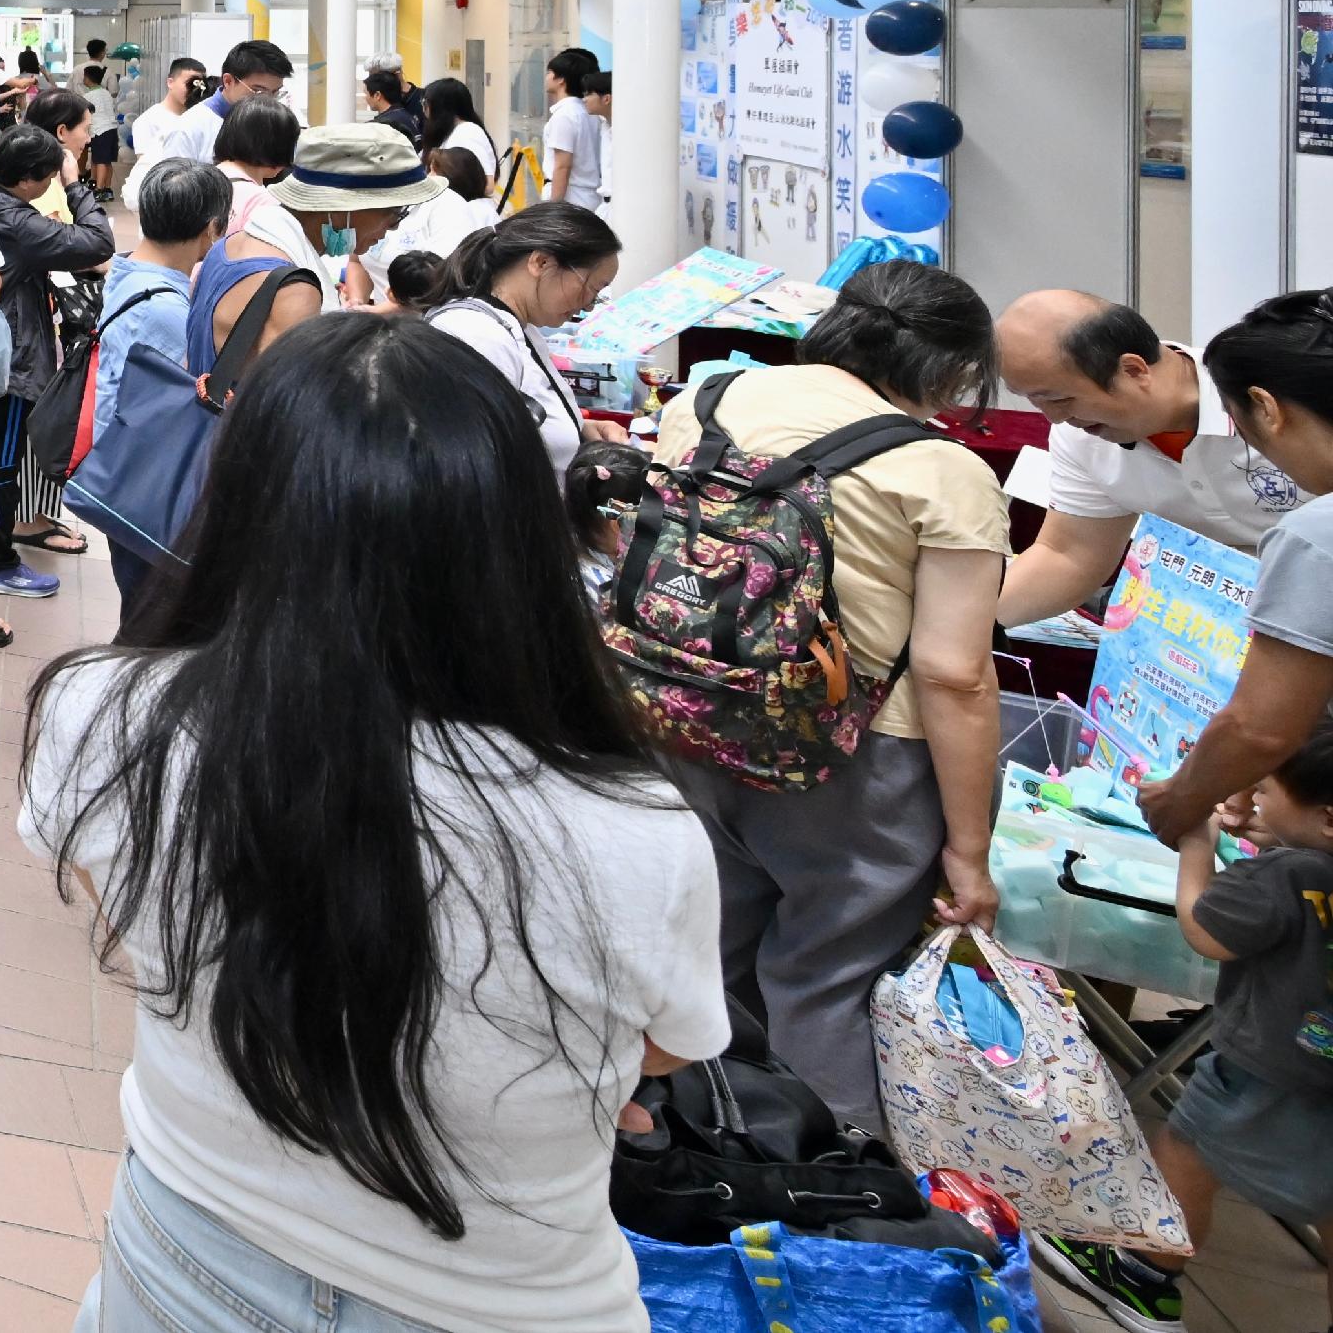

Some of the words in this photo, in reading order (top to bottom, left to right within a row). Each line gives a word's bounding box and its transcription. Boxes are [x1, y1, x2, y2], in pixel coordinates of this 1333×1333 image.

[1160, 549, 1186, 574] 屯門
[1188, 564, 1216, 588] 元朗
[654, 582, 707, 606] GREGORY
